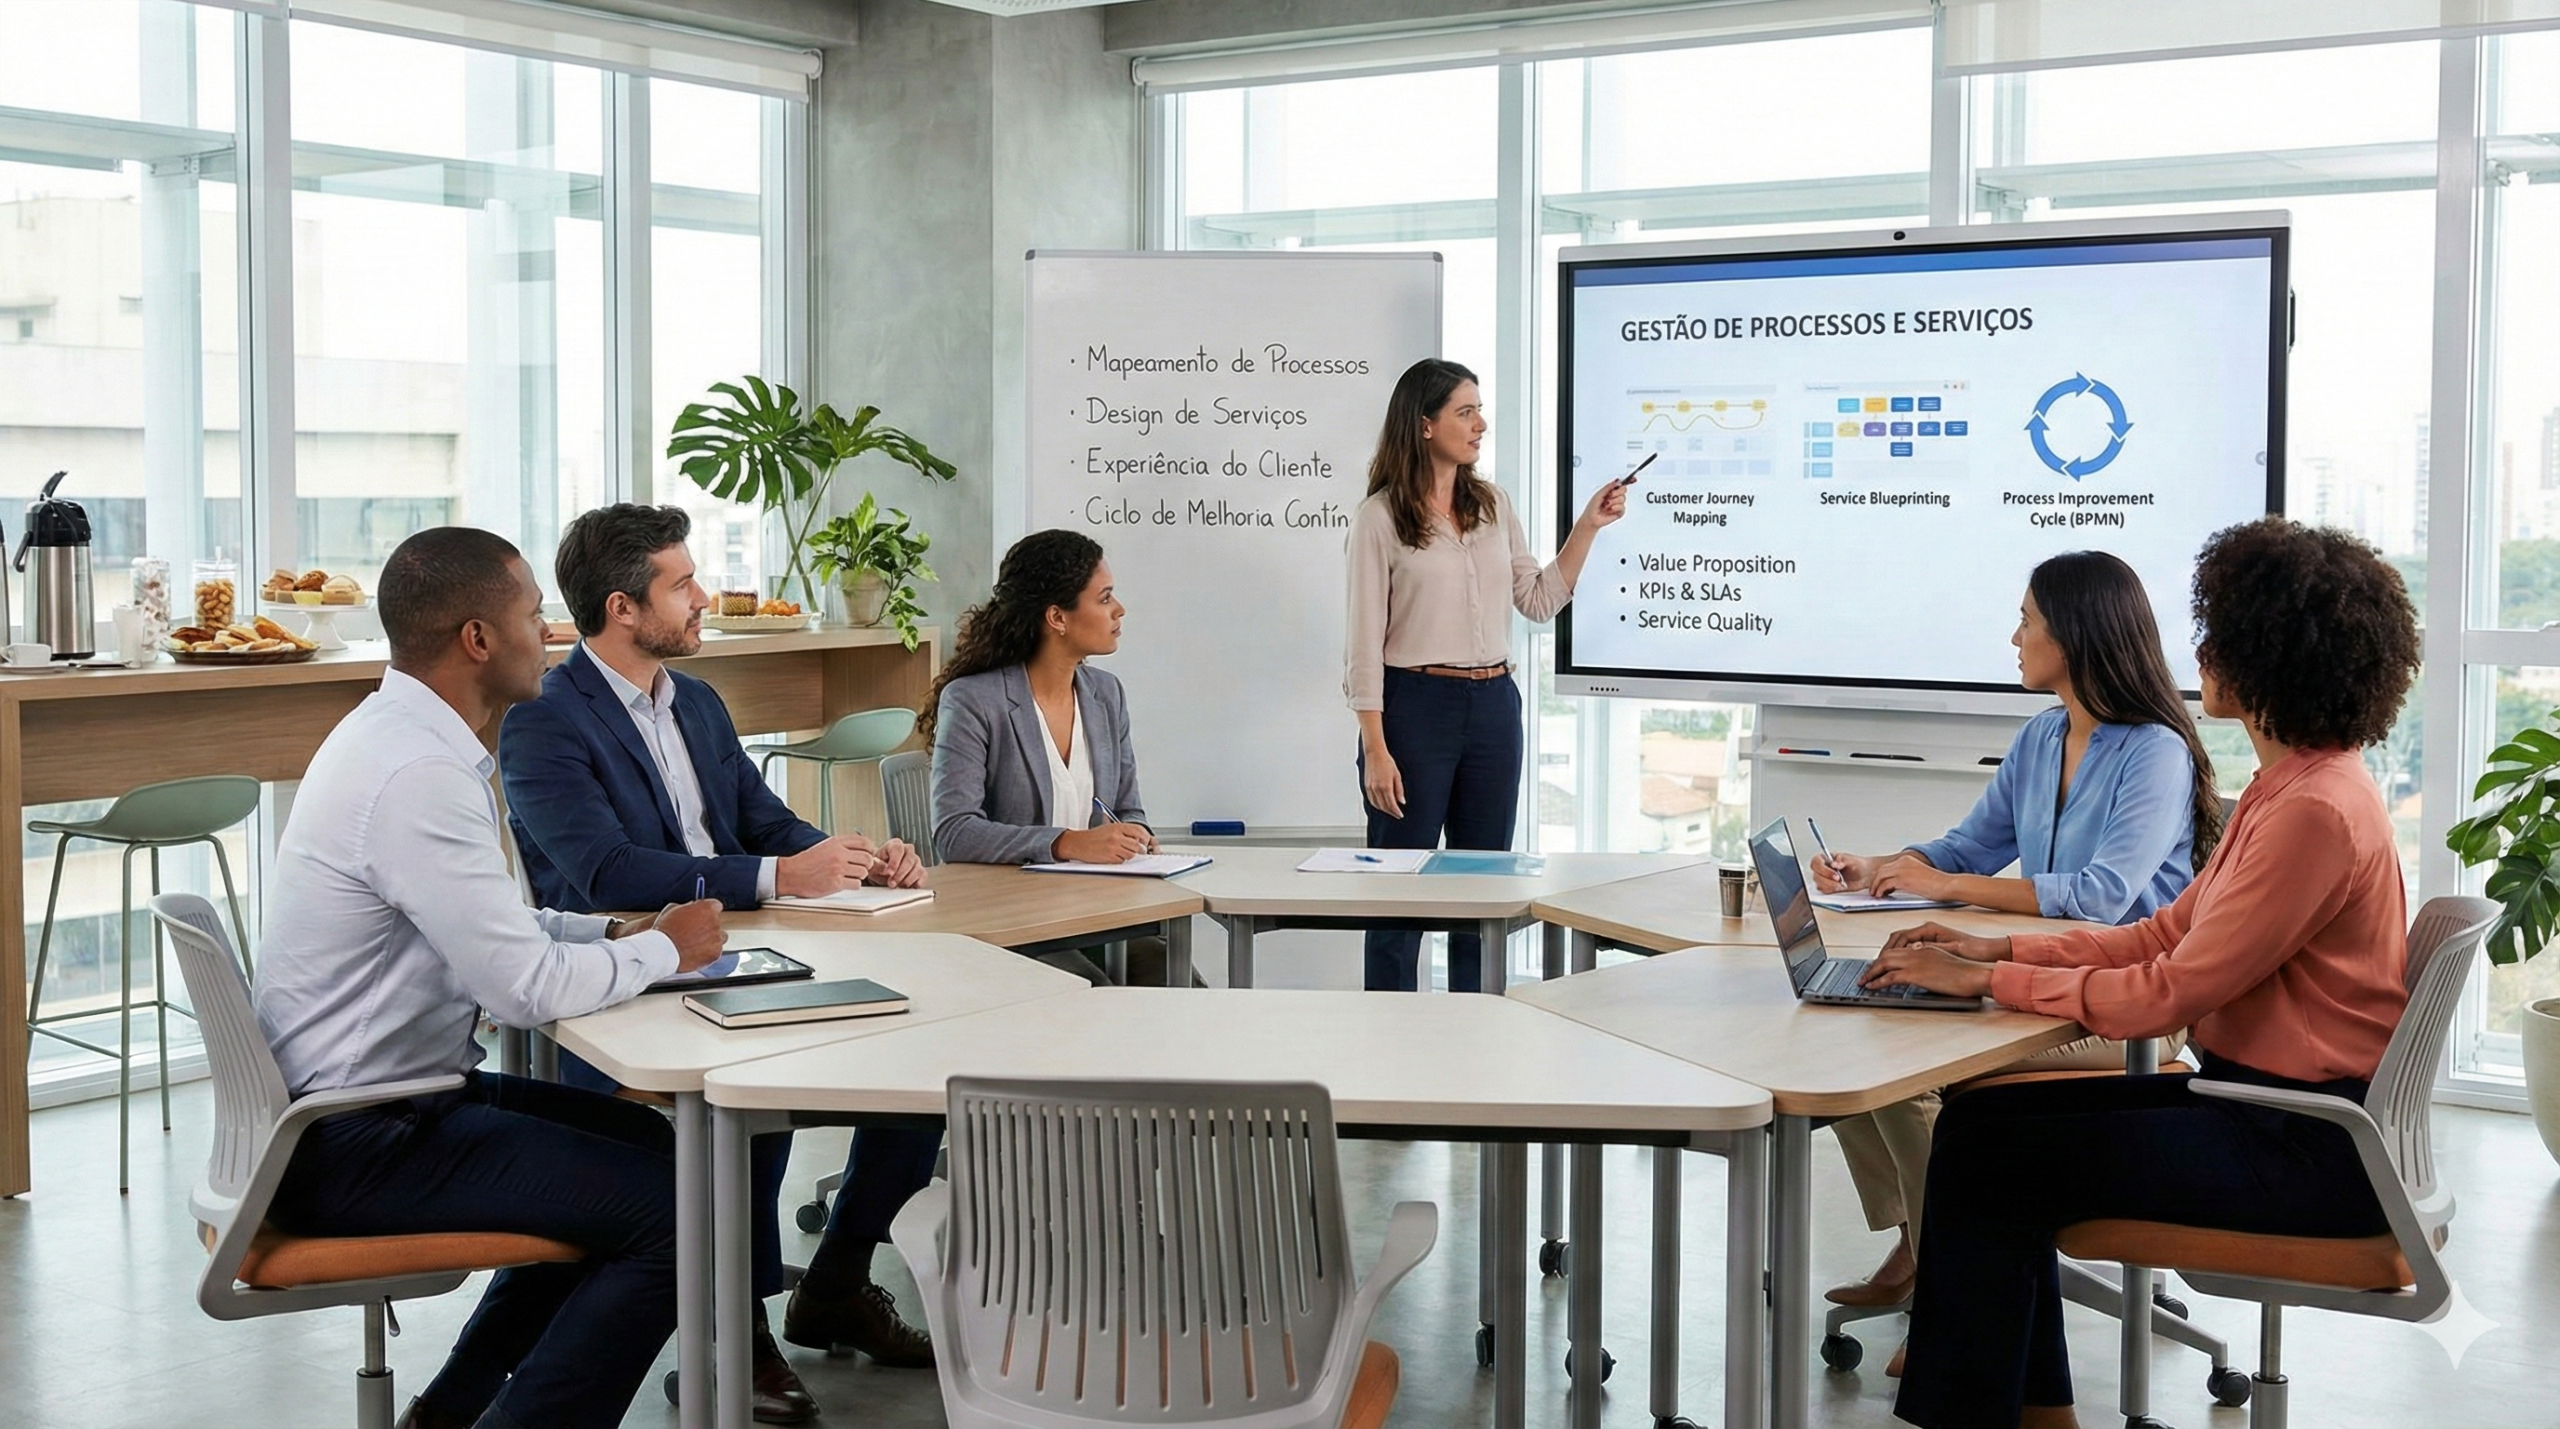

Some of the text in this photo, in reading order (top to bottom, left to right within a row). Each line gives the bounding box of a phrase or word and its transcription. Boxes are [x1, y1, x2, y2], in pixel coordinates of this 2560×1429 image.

[1621, 307, 2033, 342] GESTÃO DE PROCESSOS E SERVIÇOS
[1087, 343, 1370, 381] Mapeamento de Processos
[1086, 396, 1308, 437] Design de Serviços
[1087, 446, 1333, 483] Experiência do Cliente
[1085, 495, 1350, 529] Ciclo de Melhoria Contín
[1645, 491, 1755, 508] Customer Journey
[1820, 491, 1951, 508] Service Blueprinting
[2003, 491, 2155, 508] Process Improvement
[1673, 510, 1727, 528] Mapping
[2030, 511, 2125, 529] Cycle (BPMN)
[1638, 552, 1796, 577] Value Proposition
[1639, 581, 1742, 602] KPIs & SLAs
[1637, 609, 1773, 636] Service Quality
